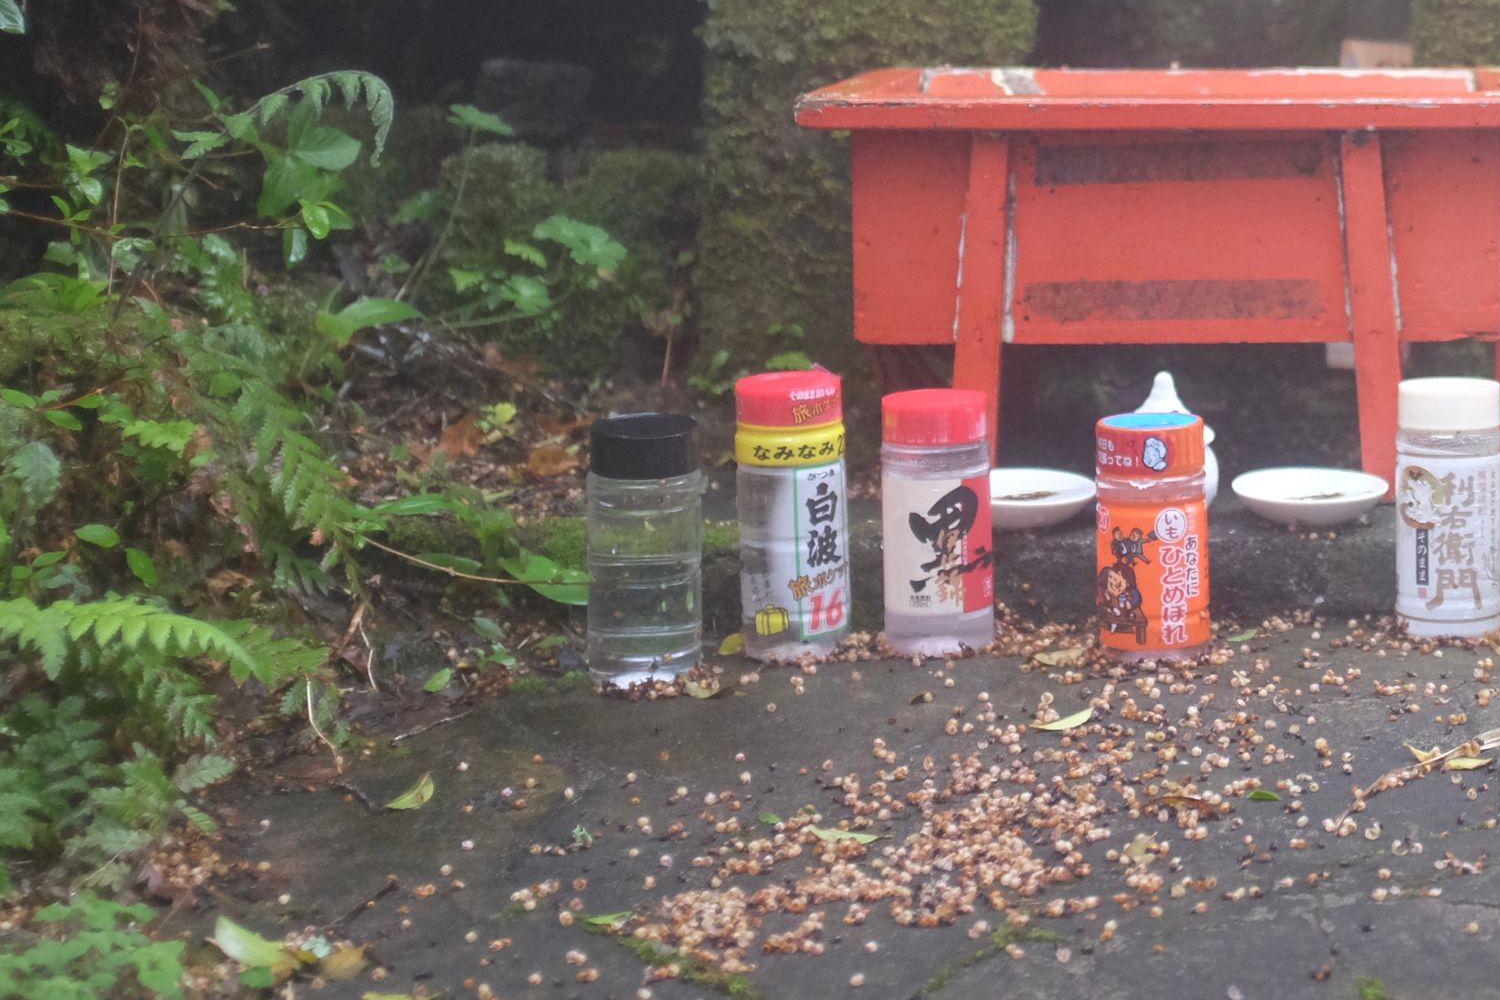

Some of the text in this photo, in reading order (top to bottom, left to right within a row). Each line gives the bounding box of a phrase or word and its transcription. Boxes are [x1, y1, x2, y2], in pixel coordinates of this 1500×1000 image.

[805, 482, 842, 568] 白波
[1165, 513, 1179, 538] いも
[1426, 472, 1483, 610] 利右衛門
[1185, 536, 1198, 596] あなたに
[1417, 530, 1428, 583] そのまま
[808, 590, 845, 634] 16
[1160, 546, 1186, 643] ひとめぼれ
